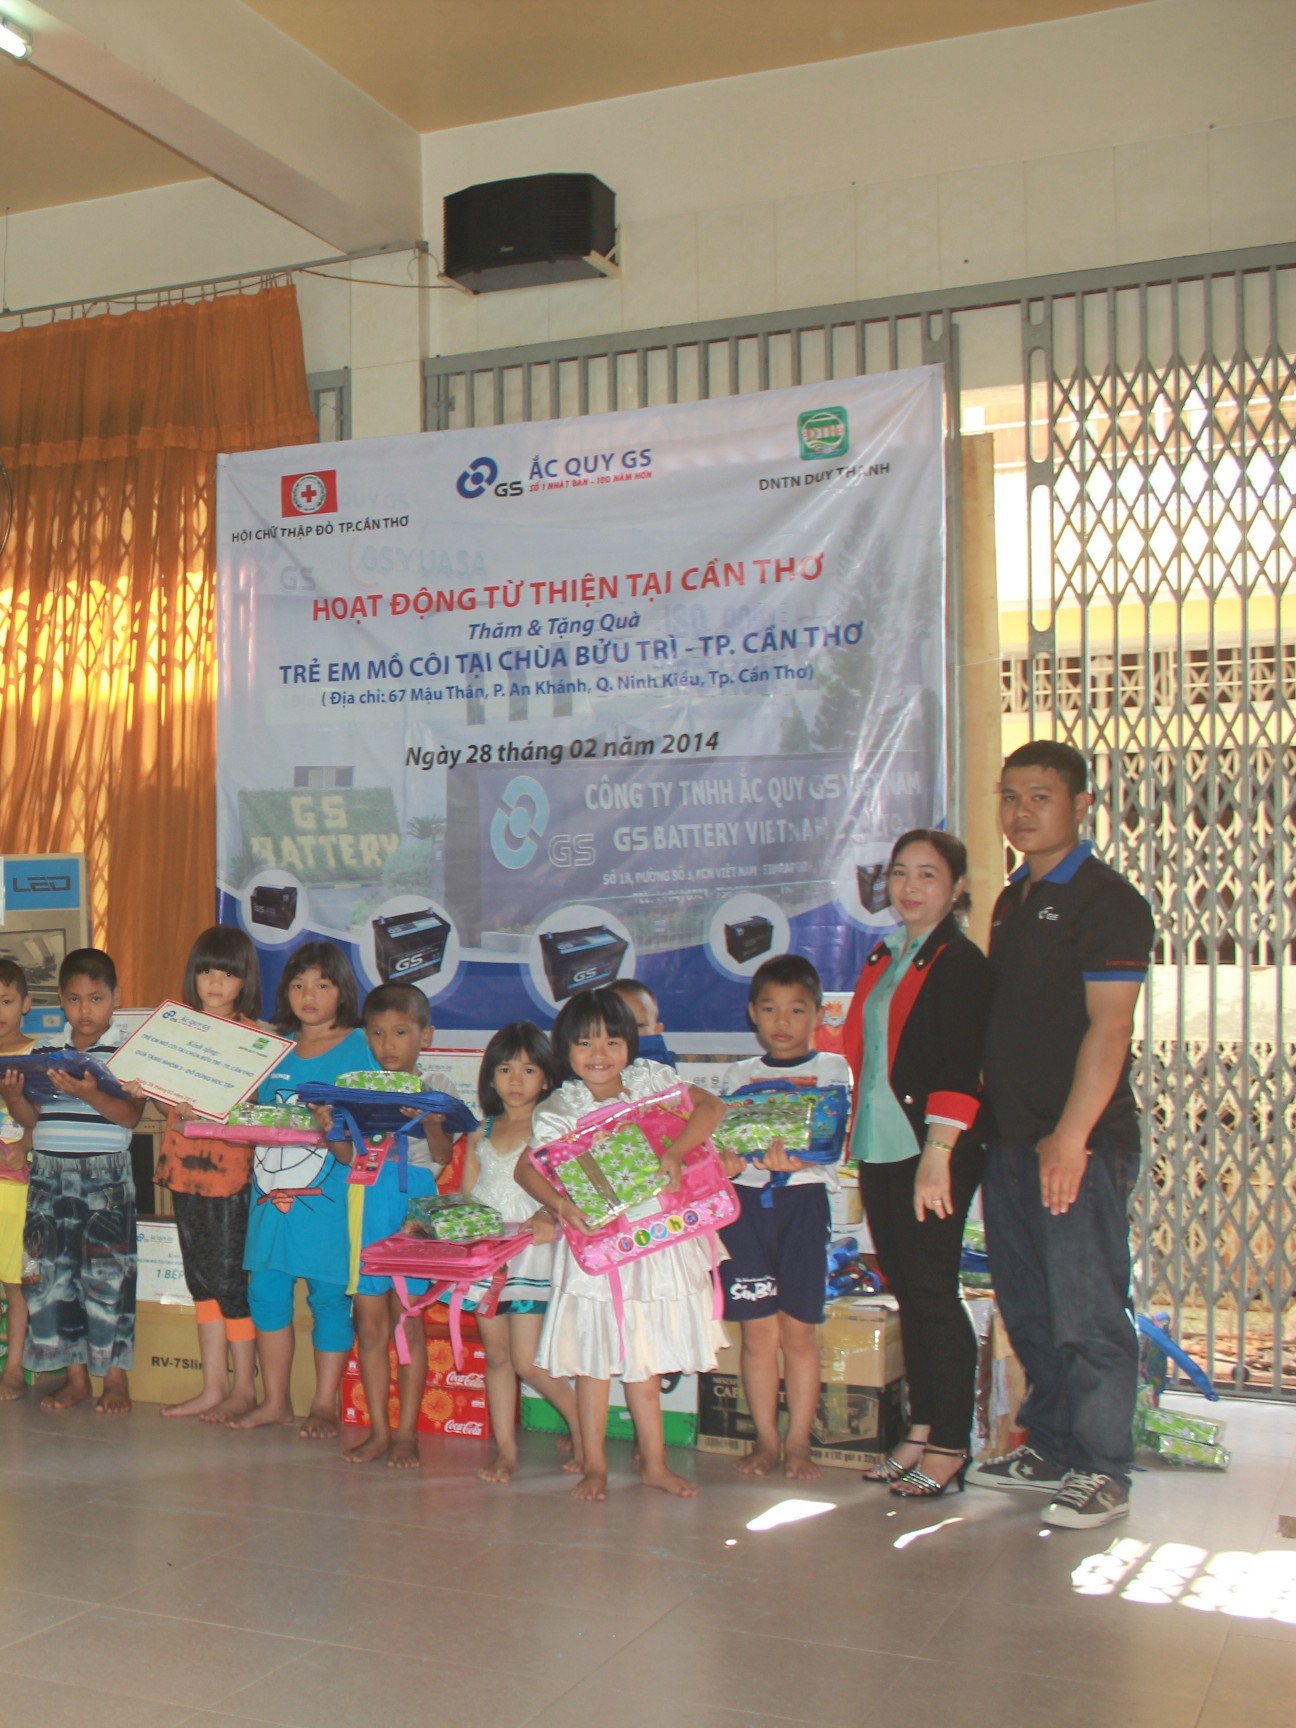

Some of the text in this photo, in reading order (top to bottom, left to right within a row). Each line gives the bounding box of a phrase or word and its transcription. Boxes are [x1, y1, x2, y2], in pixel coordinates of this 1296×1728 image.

[529, 448, 652, 480] ẮC QUY GS
[494, 481, 524, 497] GS
[759, 475, 801, 491] DNTN
[804, 470, 834, 486] DUY
[232, 529, 253, 545] HỘI
[255, 525, 278, 542] CHỮ
[280, 524, 313, 541] THẬP
[315, 520, 334, 536] ĐỎ
[383, 515, 410, 528] THƠ
[312, 552, 825, 625] HOẠT ĐỘNG TỪ THIỆN TẠI CẦN THƠ
[468, 611, 640, 640] Thăm & Tặng Quà
[279, 658, 321, 685] TRẺ
[327, 661, 361, 683] EM
[367, 652, 403, 680] MỒ
[409, 652, 450, 678] CÔI
[455, 652, 492, 679] TẠI
[498, 645, 568, 672] CHÙA
[576, 638, 629, 667] BỬU
[636, 635, 678, 661] TRÌ
[699, 635, 735, 657] TP.
[742, 625, 797, 654] CẦN
[804, 621, 864, 647] THƠ
[330, 691, 355, 708] Địa
[359, 687, 385, 704] chỉ:
[388, 689, 406, 703] 67
[410, 687, 442, 704] Mậu
[446, 684, 489, 701] Thân,
[493, 683, 505, 697] P.
[509, 682, 530, 697] An
[535, 678, 591, 696] Khánh,
[596, 677, 613, 692] Q.
[617, 673, 657, 690] Ninh
[708, 670, 734, 688] Tp.
[774, 664, 814, 680] Thơ)
[405, 731, 720, 771] Ngày 28 tháng 02 năm 2014
[585, 774, 643, 810] CÔNG
[648, 781, 673, 808] TY
[678, 776, 733, 806] TNHH
[739, 768, 765, 804] ẮC
[767, 776, 805, 808] QUY
[808, 773, 840, 799] GS
[290, 795, 349, 829] GS
[548, 834, 596, 868] GS
[614, 827, 649, 851] GS
[654, 821, 739, 850] BATTERY
[13, 875, 72, 893] LED
[395, 954, 424, 972] GS
[573, 967, 597, 983] GS
[156, 1269, 161, 1278] 1
